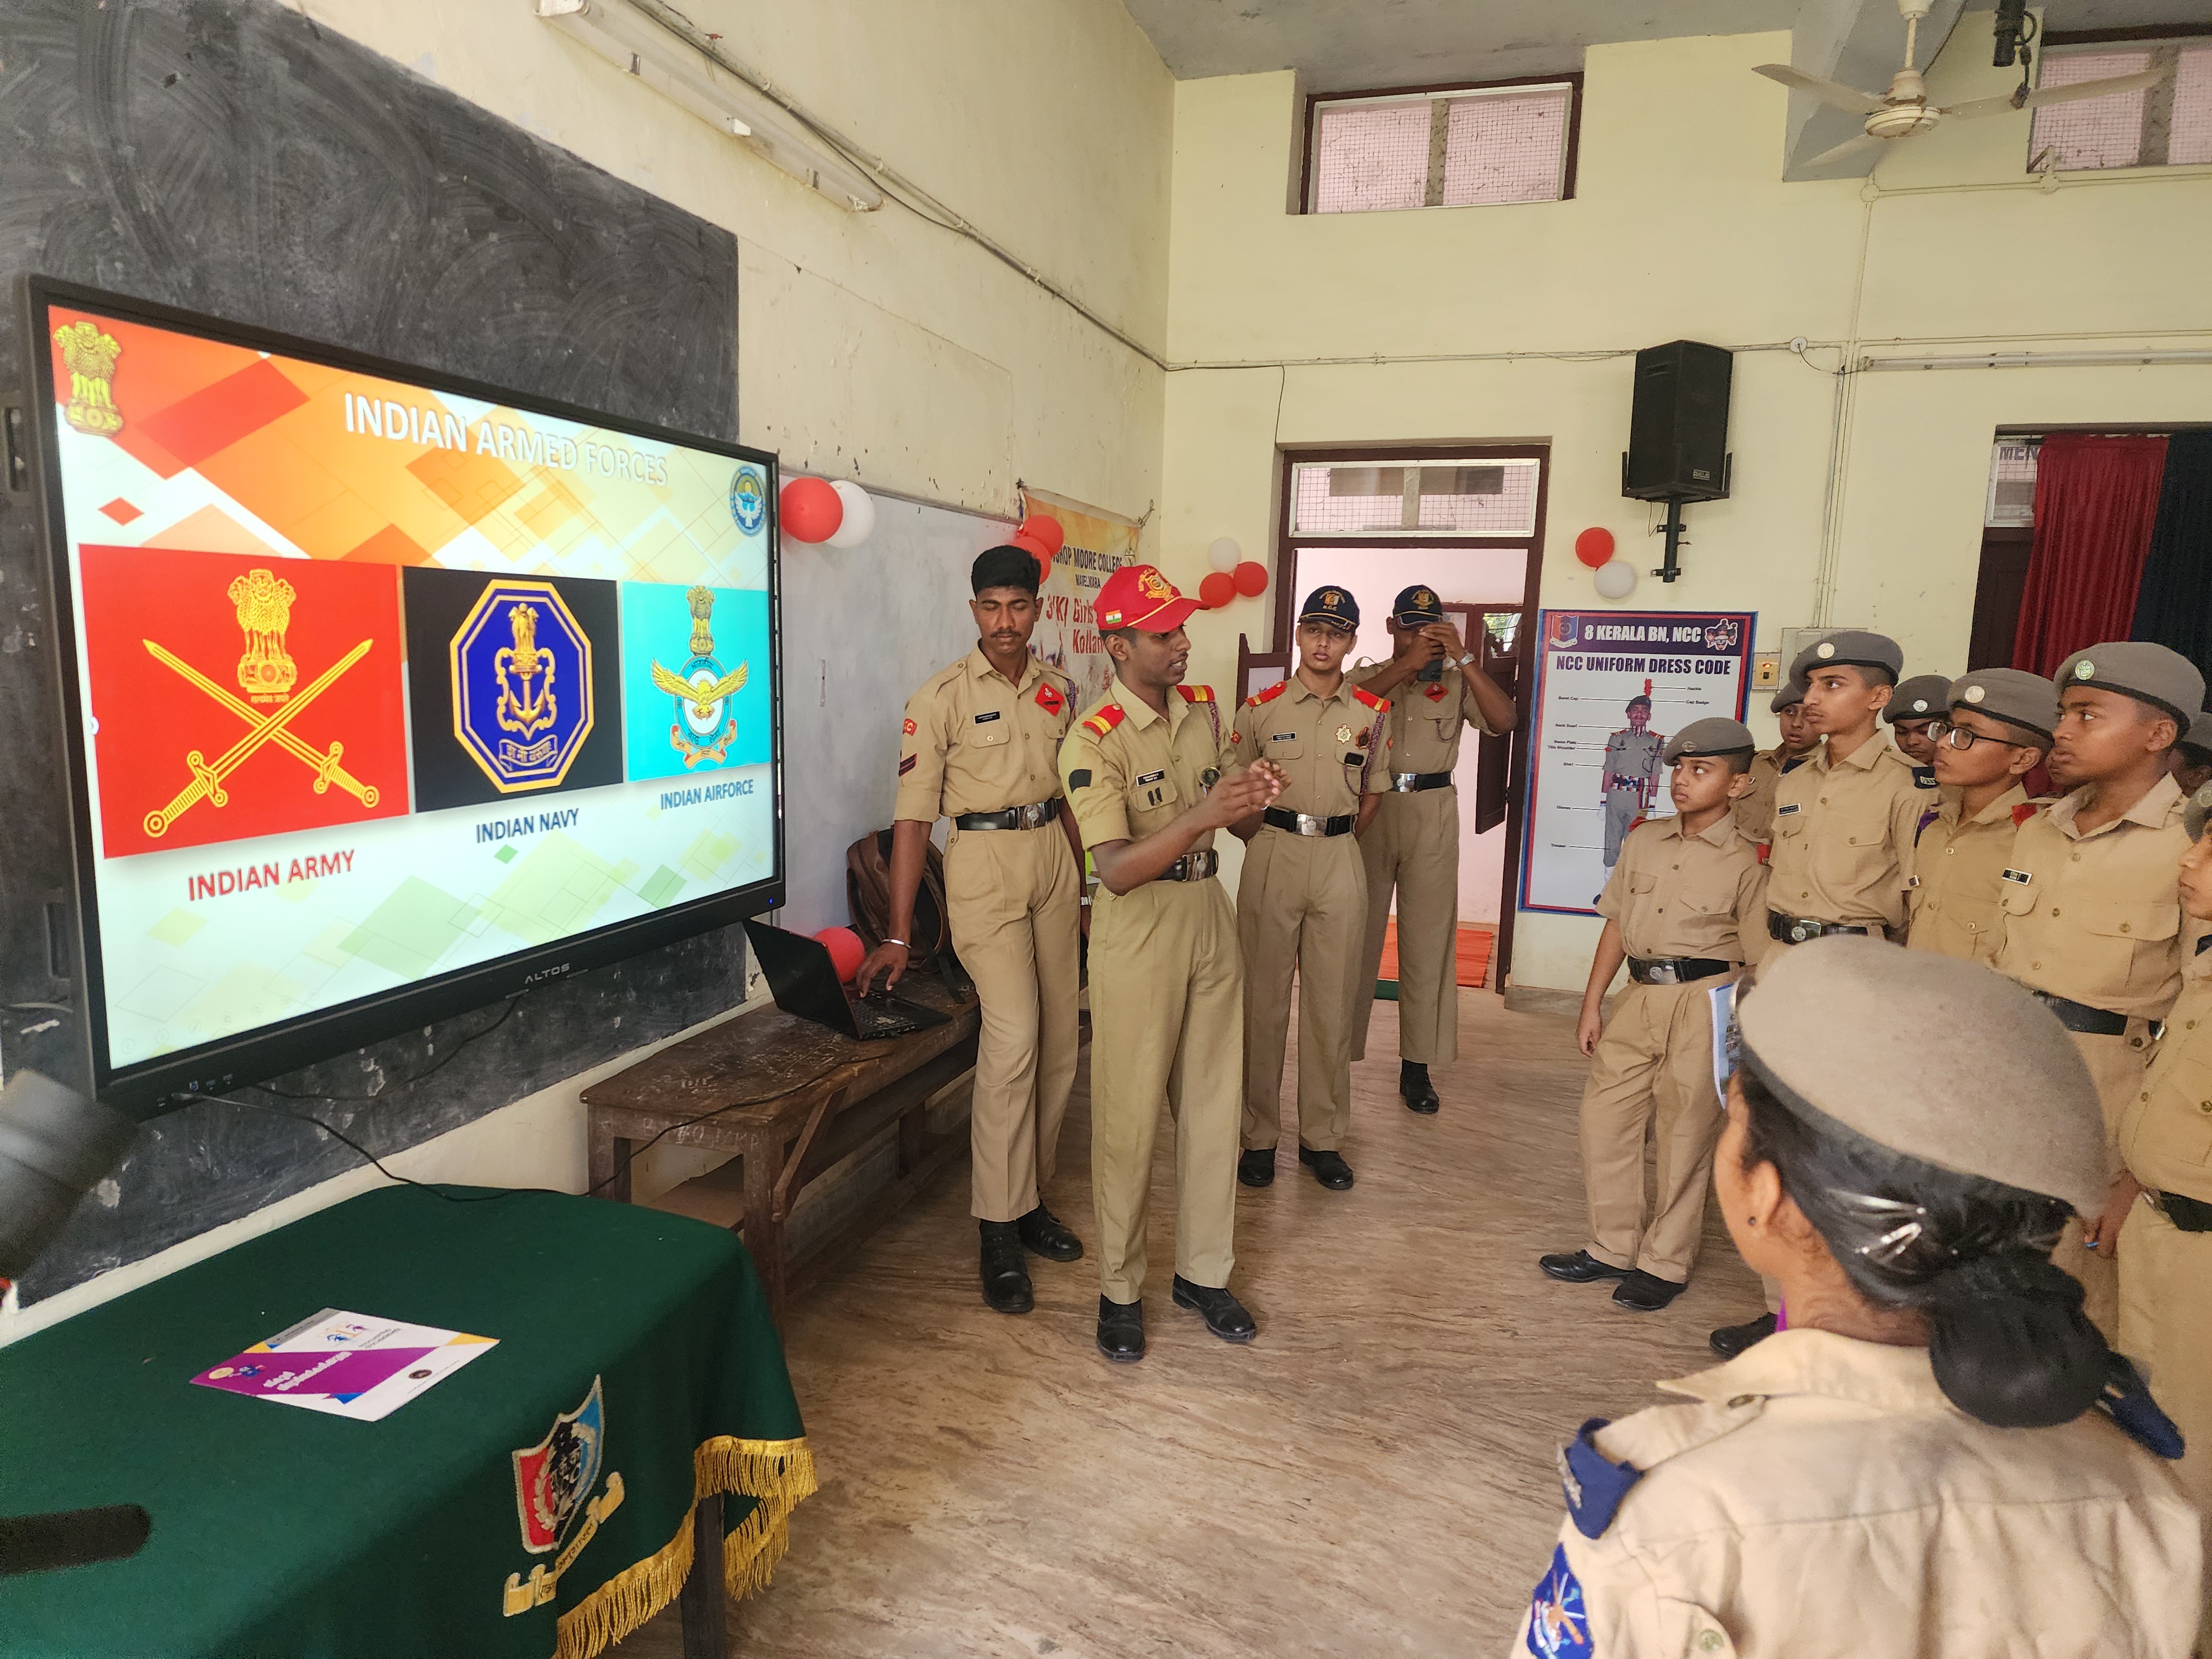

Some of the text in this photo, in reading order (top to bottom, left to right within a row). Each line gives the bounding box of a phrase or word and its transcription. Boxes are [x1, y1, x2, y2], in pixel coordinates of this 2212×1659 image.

[345, 392, 667, 487] INDIAN ARMED FORCES
[1052, 545, 1072, 566] SHOP
[1073, 547, 1097, 570] MOORE
[1073, 598, 1093, 624] Girls
[1584, 625, 1594, 640] 8
[1596, 625, 1646, 641] KERALA
[1673, 627, 1702, 643] NCC
[1556, 655, 1731, 675] NCC UNIFORM DRESS CODE
[660, 779, 754, 810] INDIAN AIRFORCE
[476, 807, 579, 844] INDIAN NAVY
[188, 849, 356, 902] INDIAN ARMY
[525, 963, 570, 984] ALTOS
